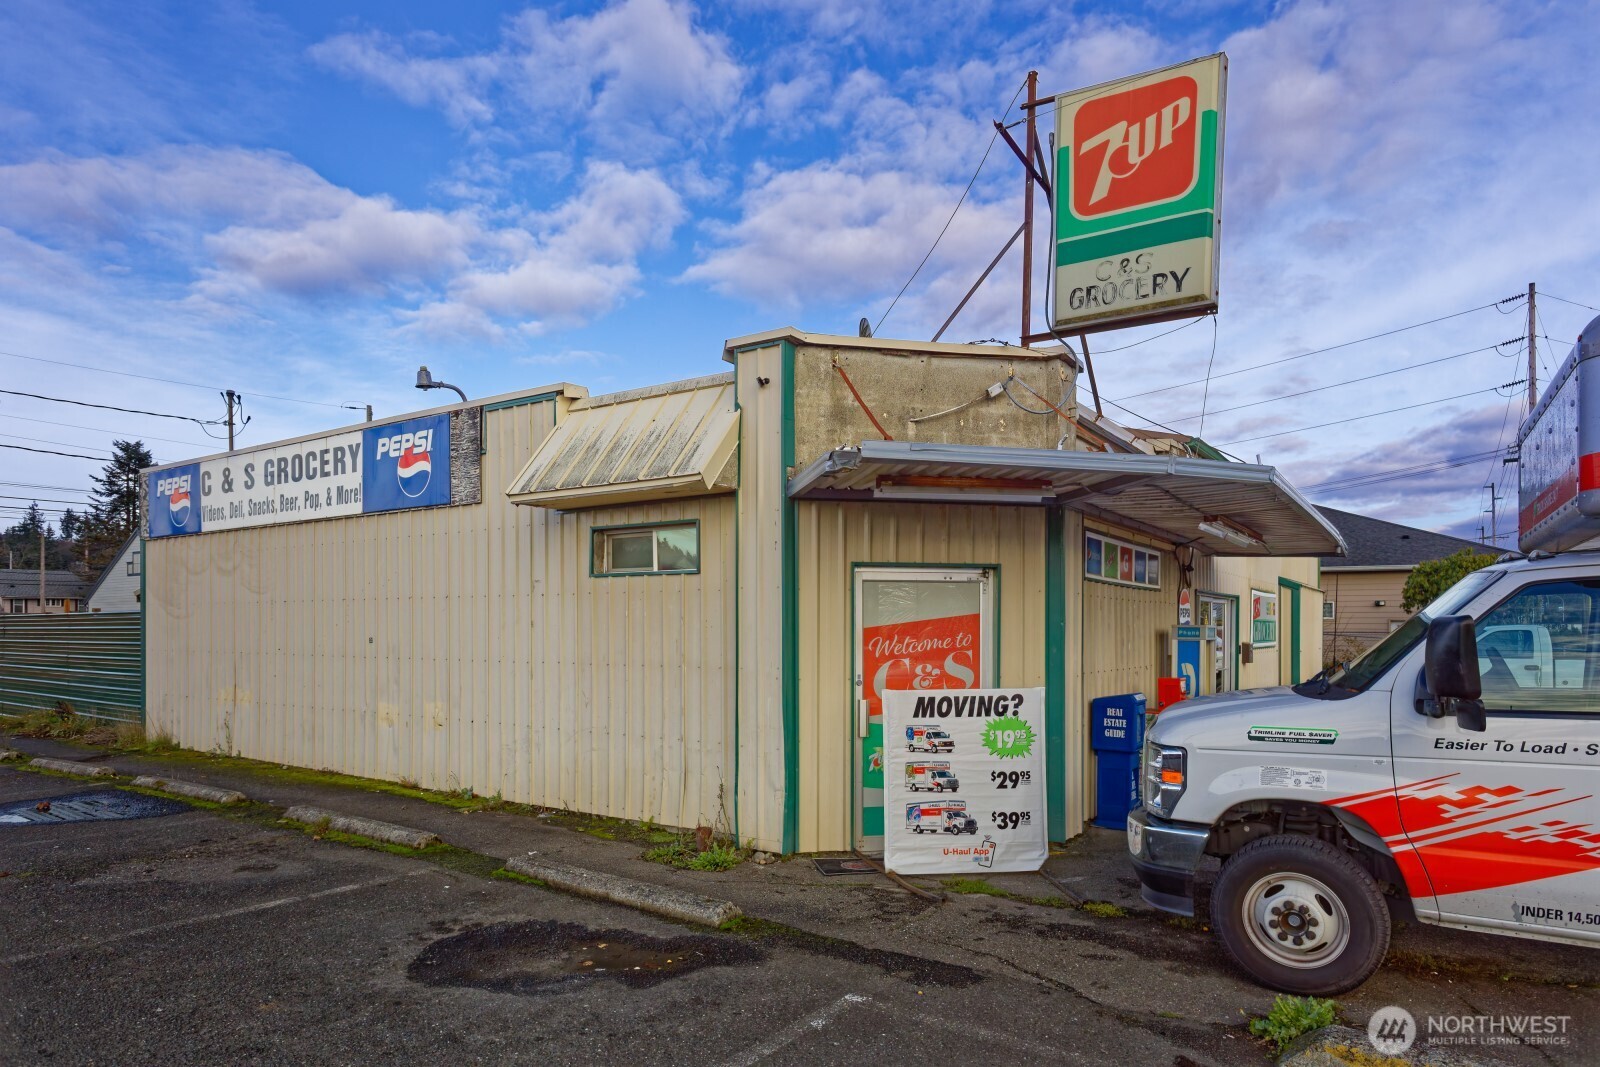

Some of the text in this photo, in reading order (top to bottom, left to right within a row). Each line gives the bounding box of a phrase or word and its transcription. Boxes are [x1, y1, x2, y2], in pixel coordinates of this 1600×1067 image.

[1079, 96, 1191, 206] 7UP
[1069, 266, 1192, 310] GROCERY
[376, 428, 433, 460] PEPSI
[201, 442, 362, 497] C & S GROCERY
[156, 474, 192, 498] PEPSI
[229, 500, 245, 520] Deli,
[248, 496, 278, 517] Snacks,
[279, 494, 300, 513] Beer,
[304, 490, 322, 511] Pop,
[325, 487, 332, 506] &
[336, 482, 362, 505] More!
[868, 632, 972, 658] Welcome to
[912, 693, 1024, 718] MOVING?
[1103, 718, 1127, 728] ESTATE
[1104, 728, 1126, 738] GUIDE
[1433, 737, 1488, 751] Easier
[1494, 740, 1514, 752] To
[1520, 741, 1568, 754] Load
[973, 848, 990, 856] App
